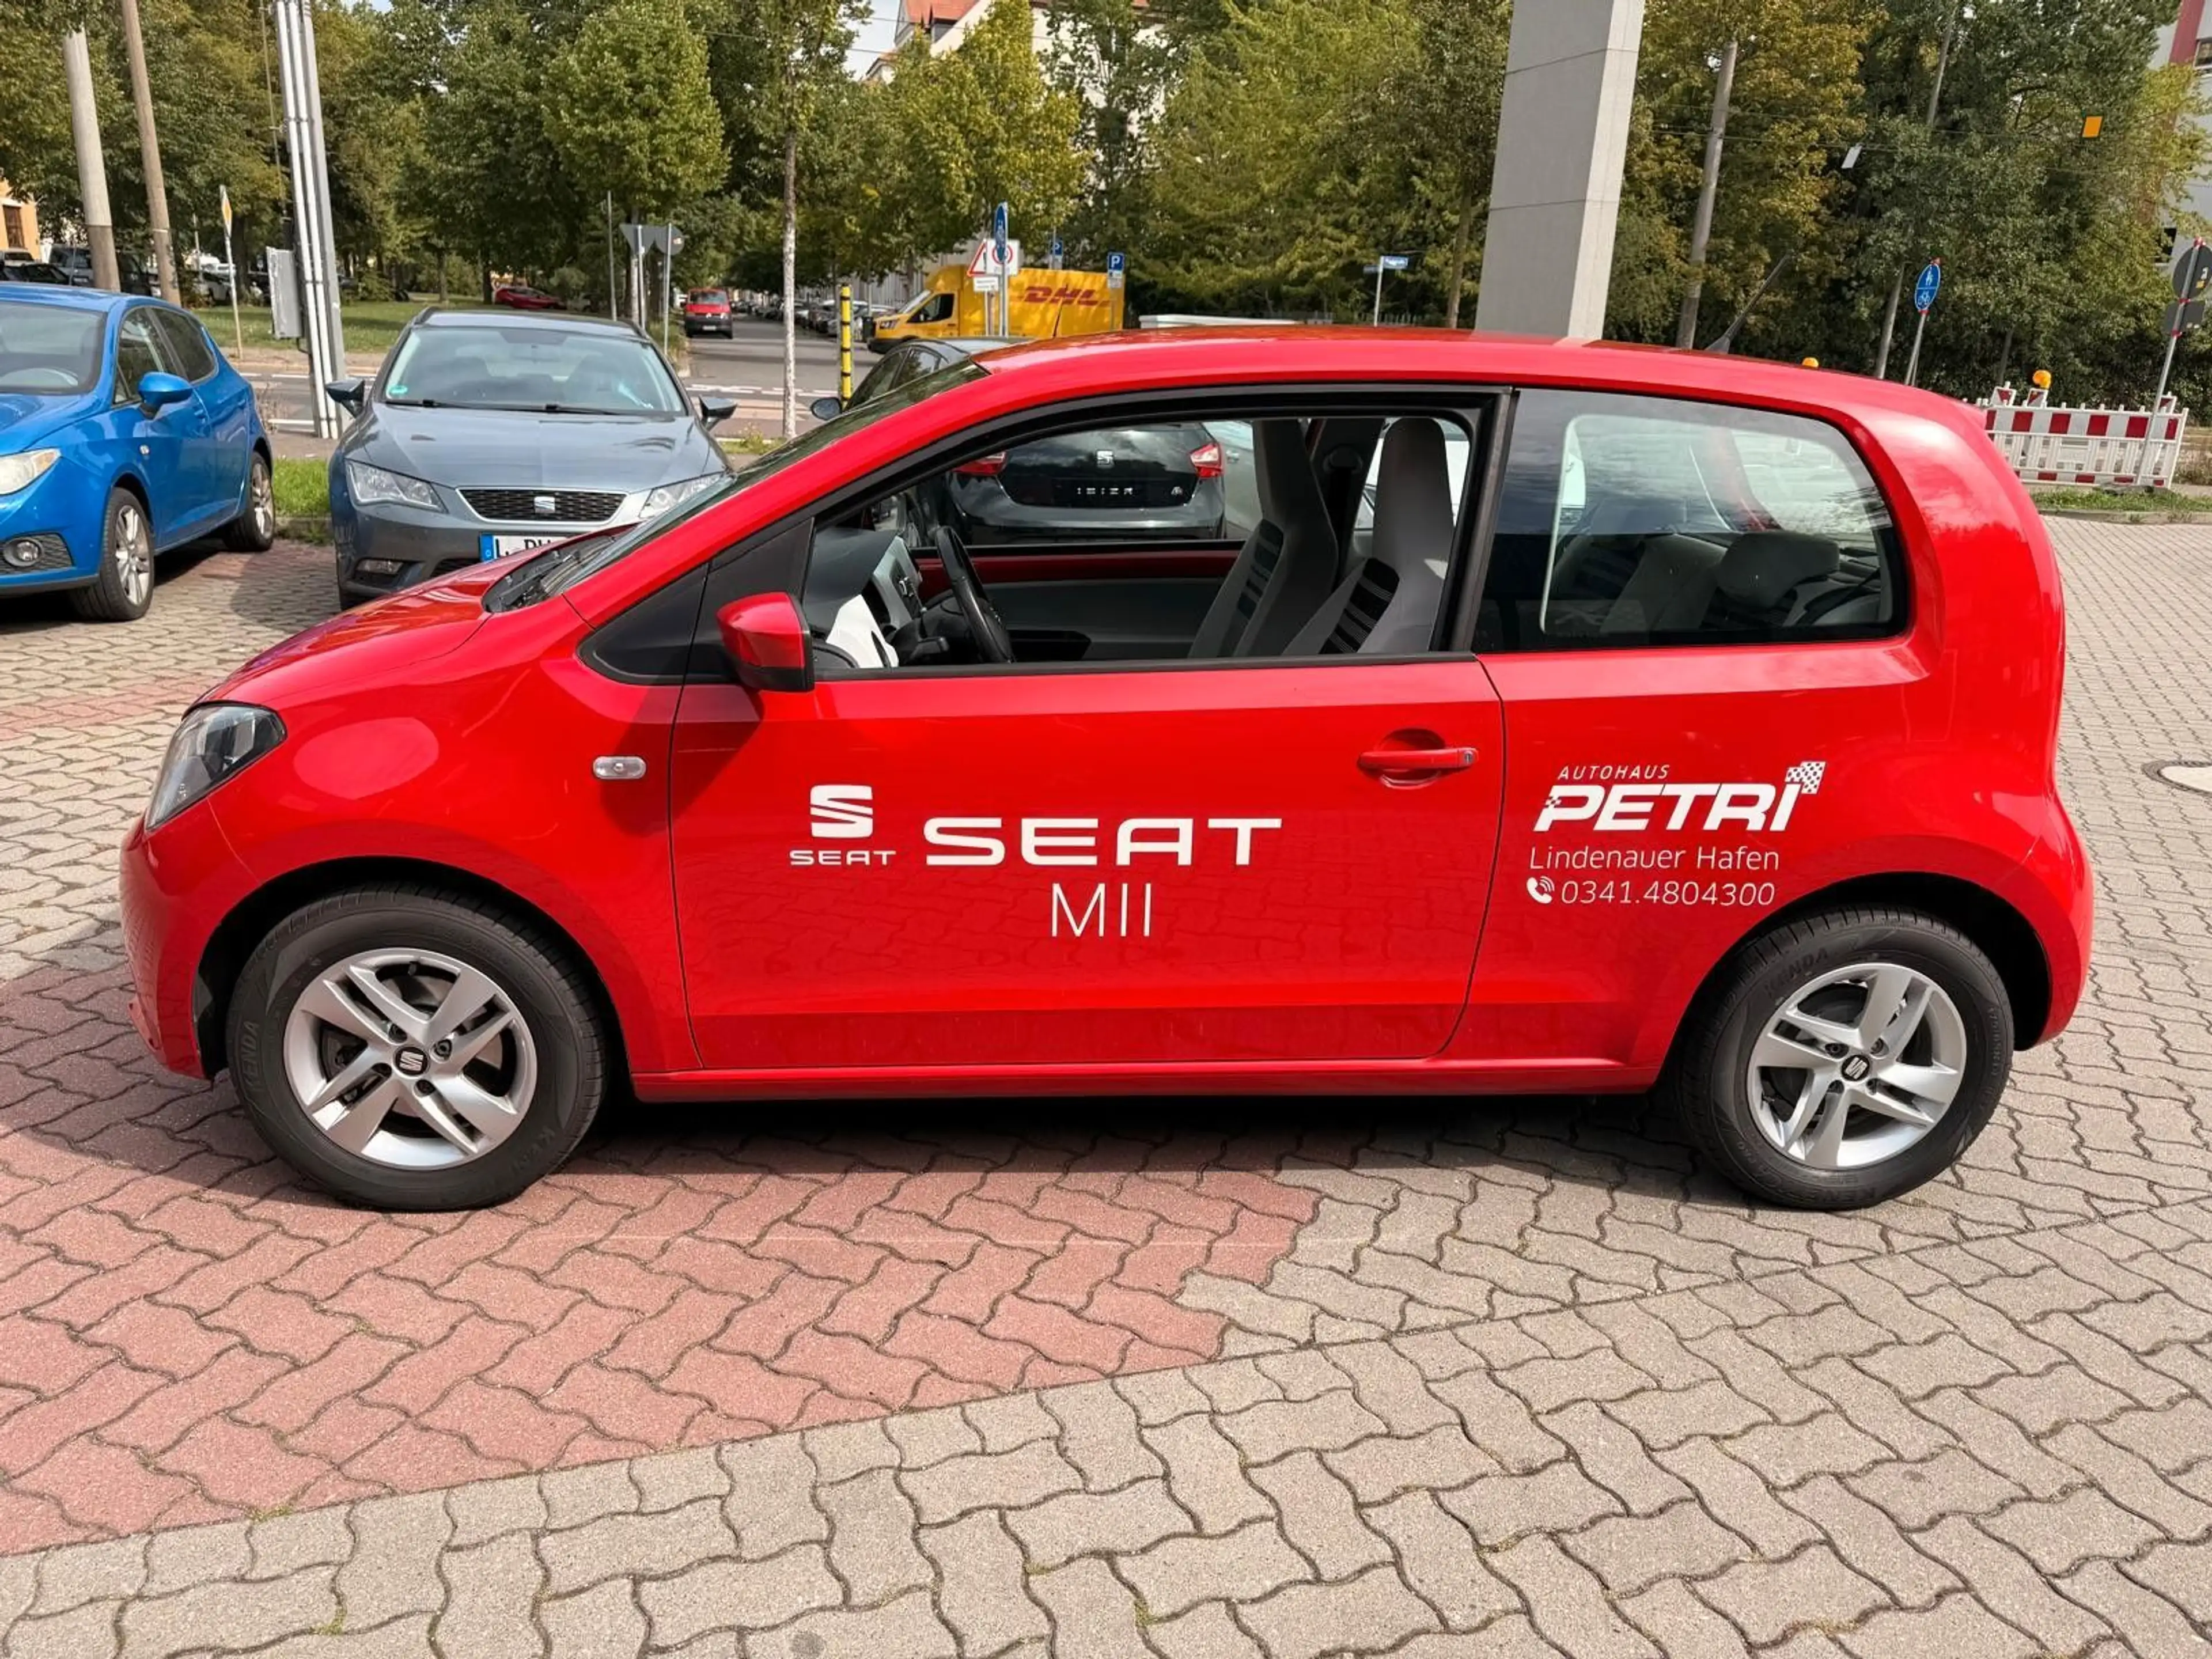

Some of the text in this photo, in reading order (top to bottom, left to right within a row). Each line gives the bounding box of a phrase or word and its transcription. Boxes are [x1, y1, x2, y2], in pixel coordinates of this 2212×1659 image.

[1111, 255, 1121, 268] P
[1024, 286, 1099, 306] DHL
[1557, 764, 1670, 780] AUTOHAUS
[1533, 781, 1803, 832] PETRI
[923, 817, 1282, 866] SEAT
[789, 850, 896, 866] SEAT
[1530, 846, 1779, 870] Lindenauer Hafen
[1562, 880, 1775, 906] 0341.4804300
[1052, 882, 1152, 937] MII
